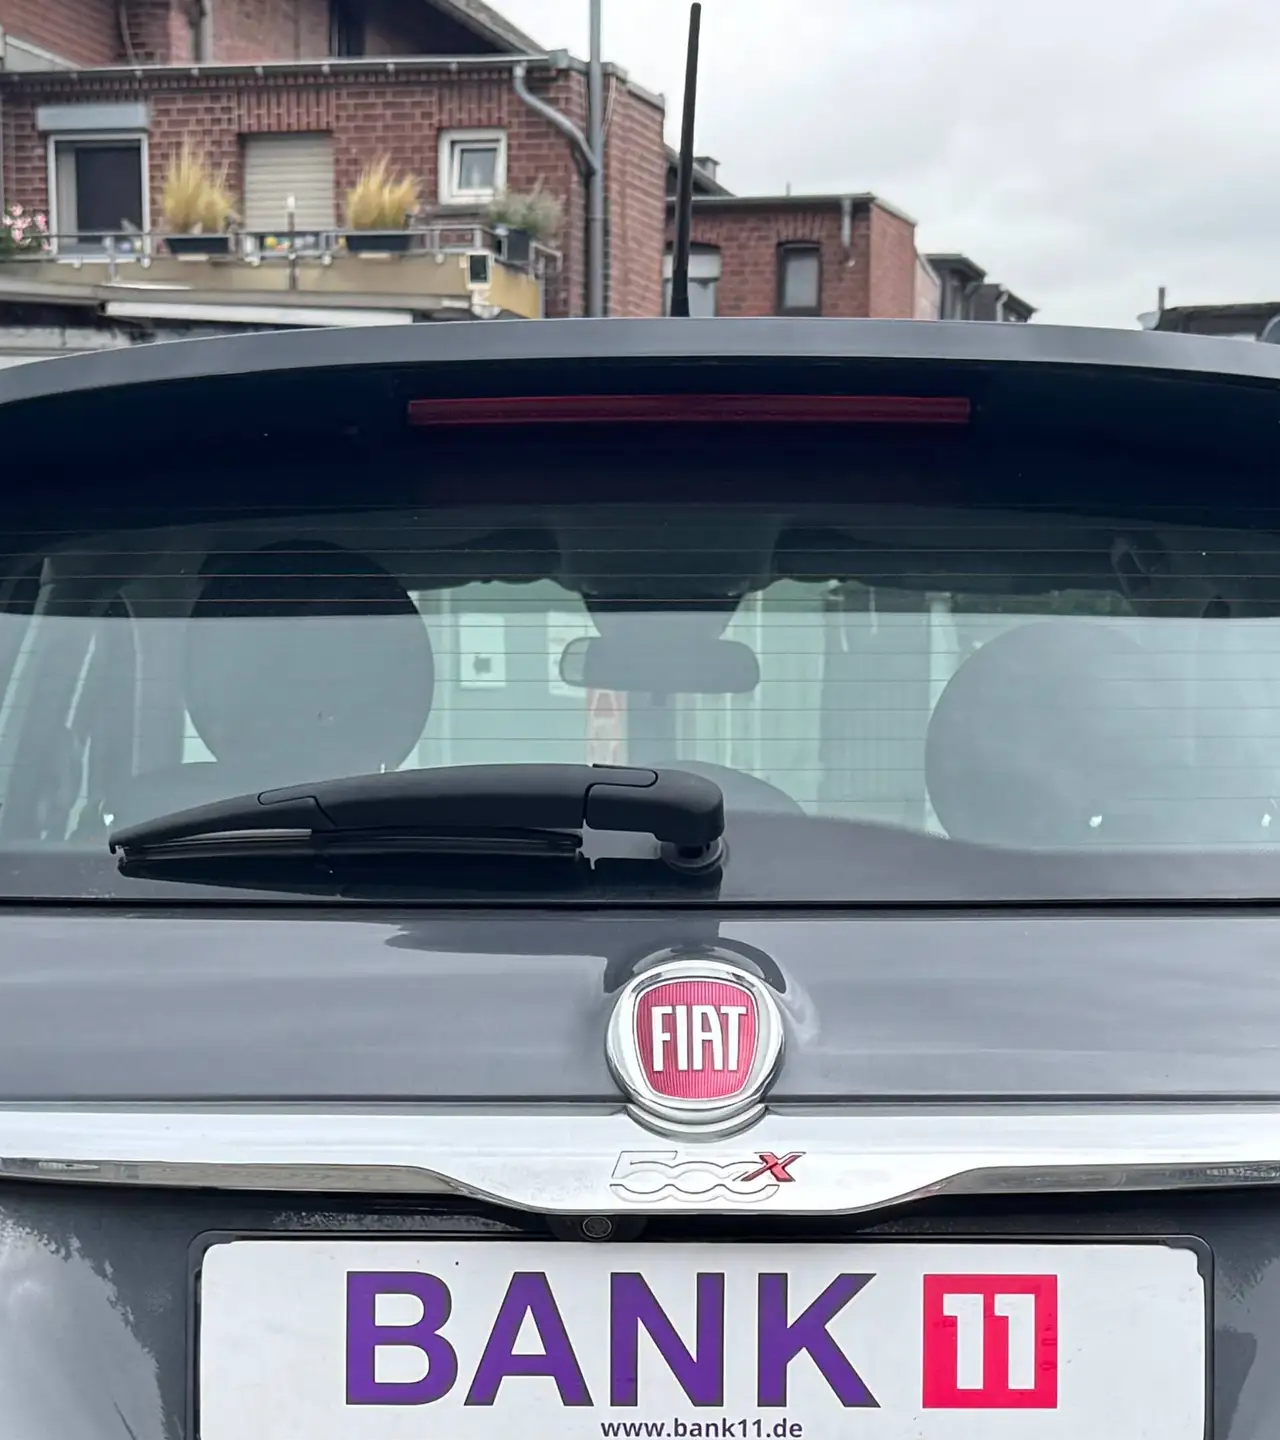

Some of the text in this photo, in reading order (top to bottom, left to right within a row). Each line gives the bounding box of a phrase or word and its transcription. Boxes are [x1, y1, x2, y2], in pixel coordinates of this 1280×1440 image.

[651, 1005, 748, 1073] FIAT
[346, 1271, 1042, 1409] BANK 11
[600, 1417, 804, 1438] www.bank11.de
